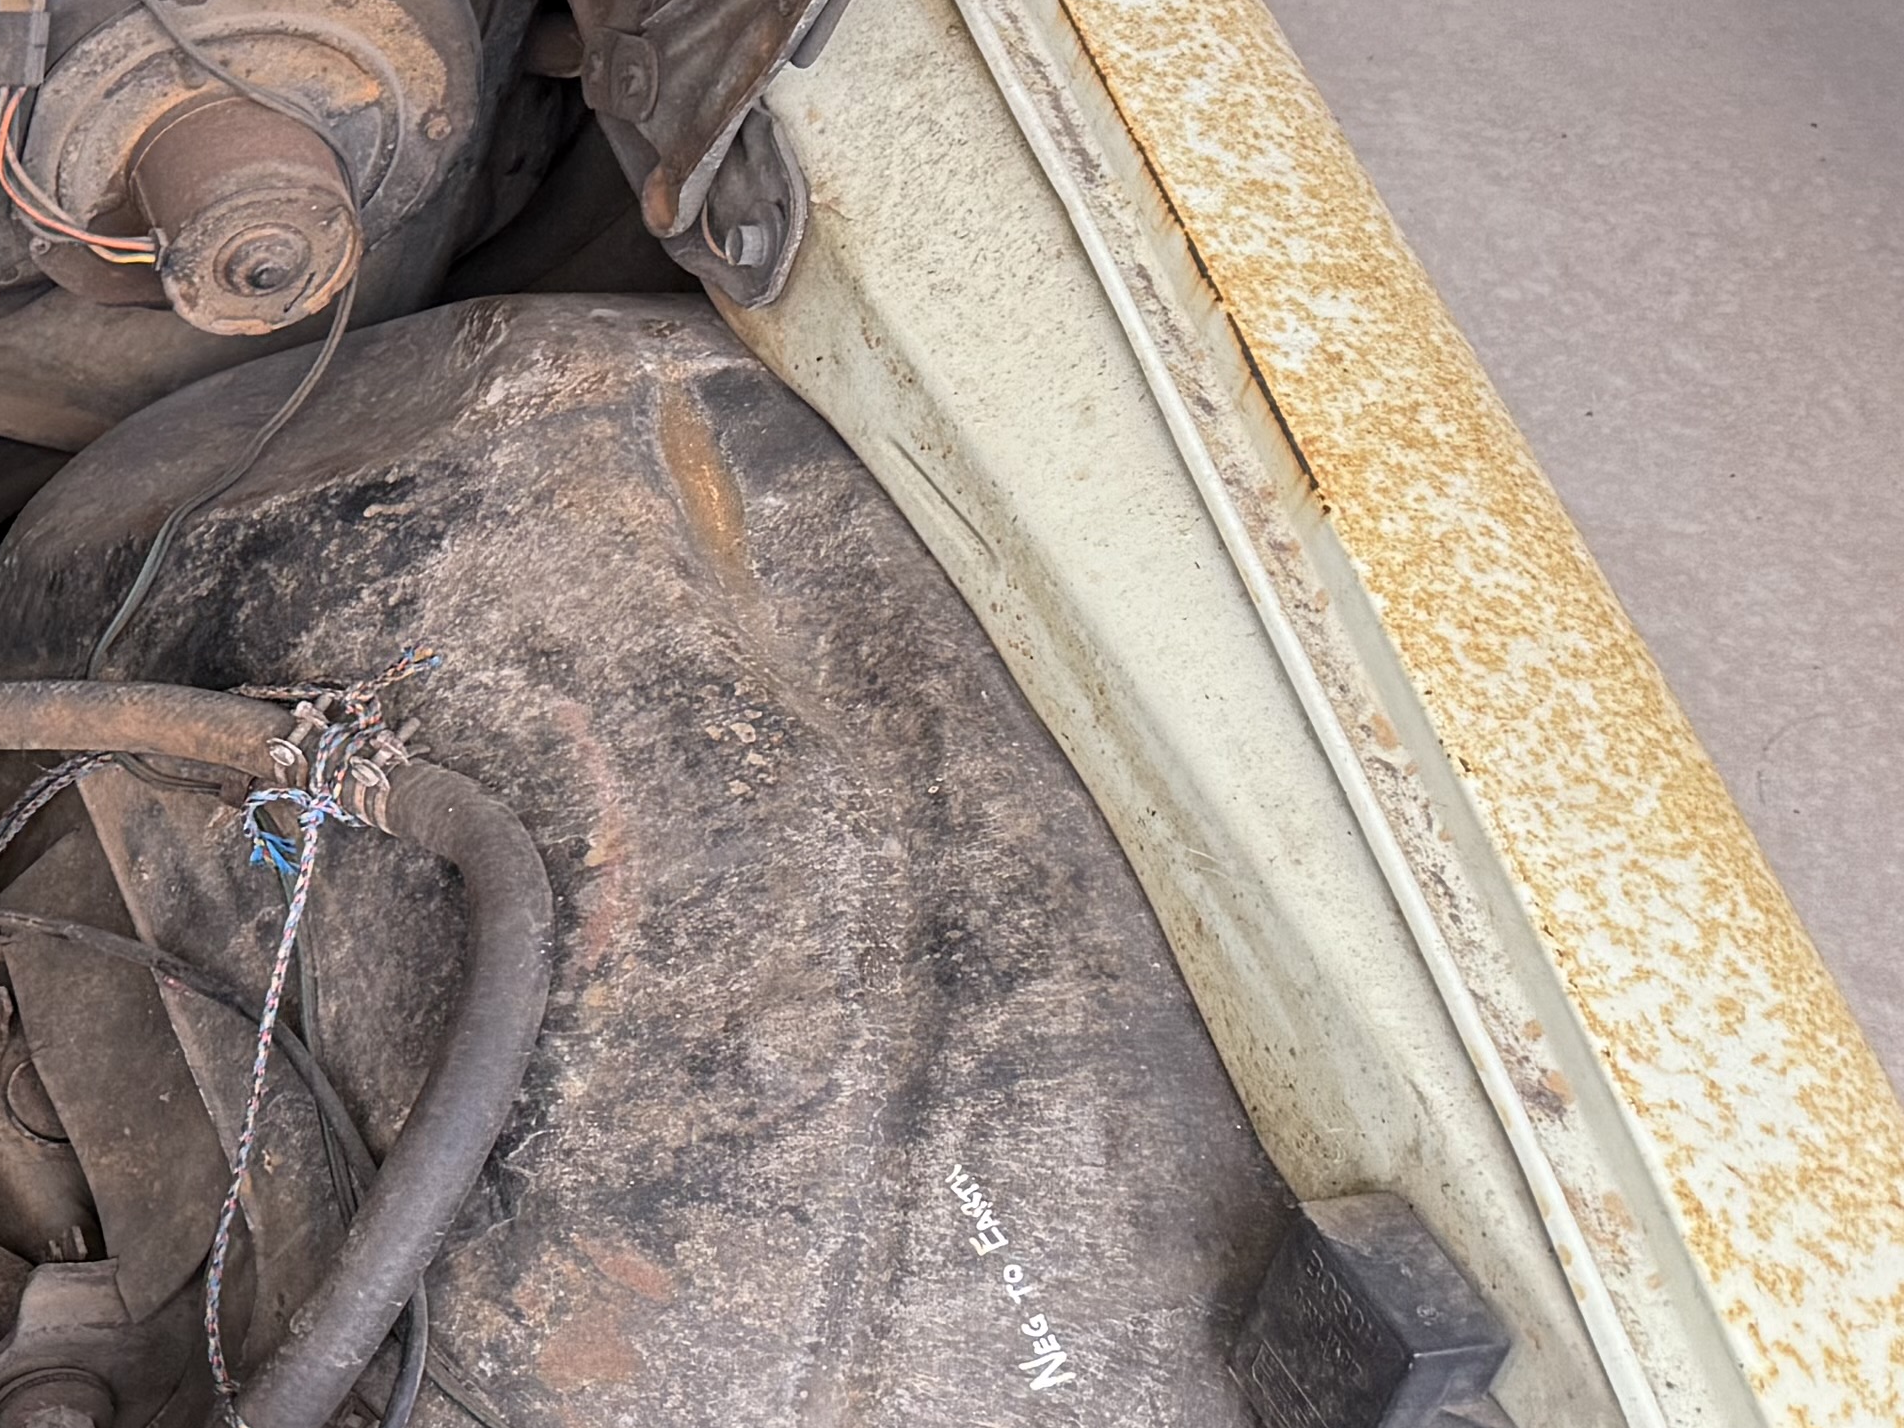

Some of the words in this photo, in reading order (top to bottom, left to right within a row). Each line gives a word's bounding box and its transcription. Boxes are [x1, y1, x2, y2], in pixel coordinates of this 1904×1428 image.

[944, 1163, 1009, 1257] EARTH
[1003, 1263, 1033, 1305] TO
[1017, 1312, 1077, 1392] NEG
